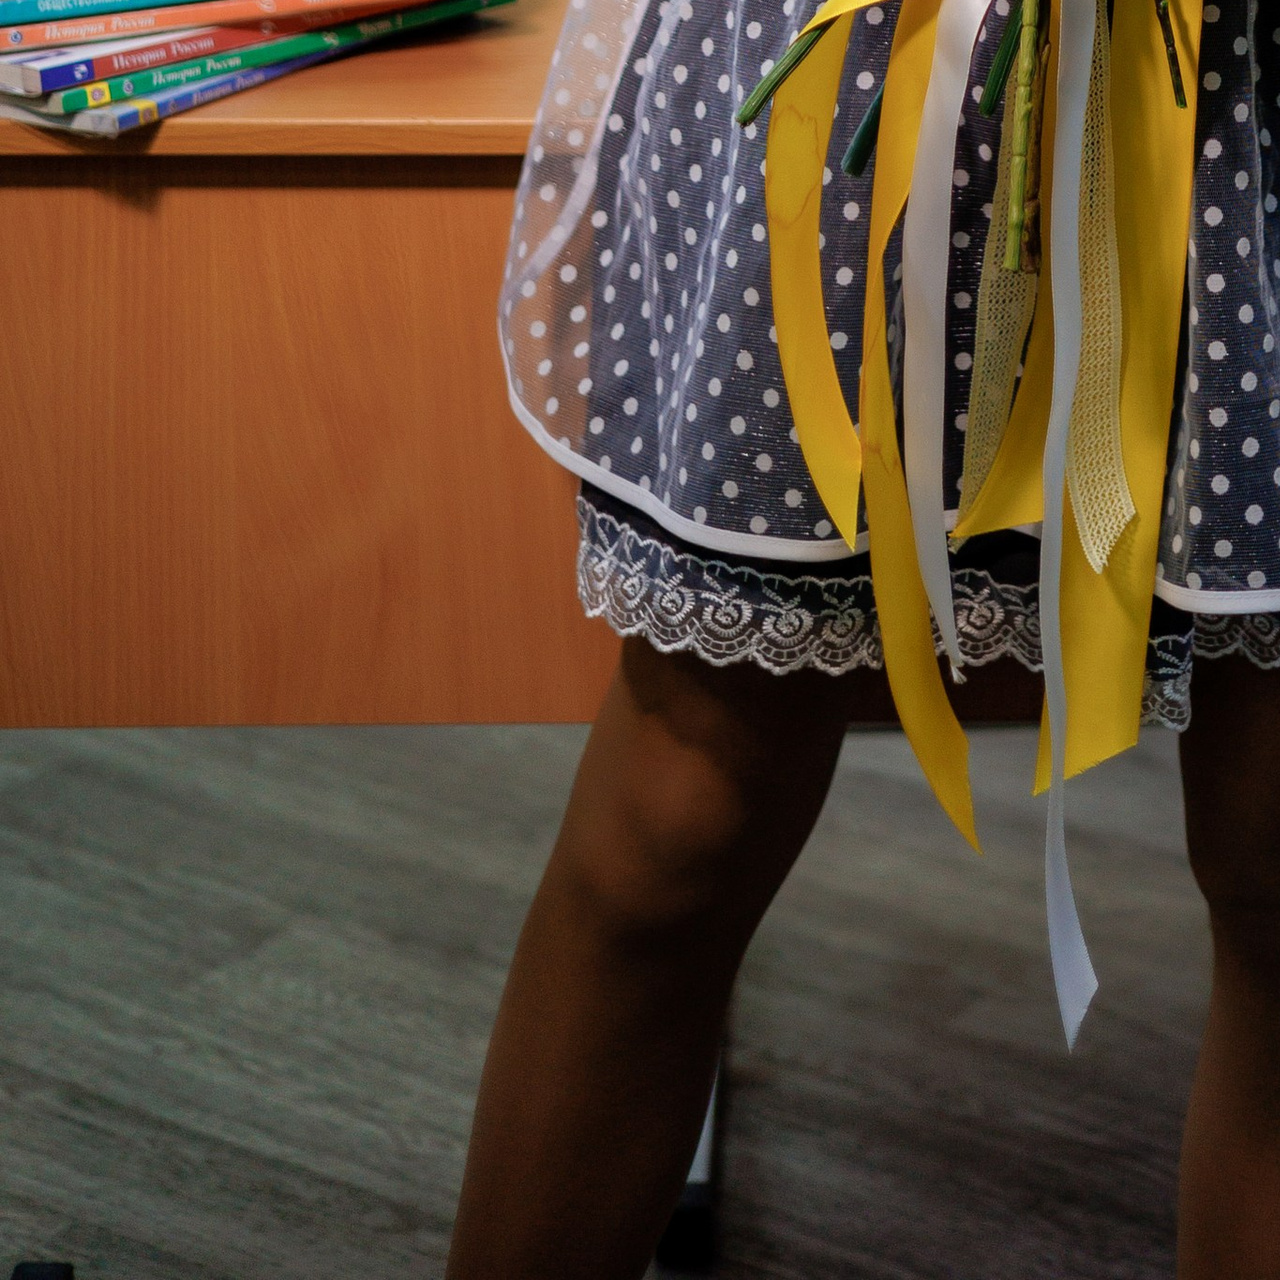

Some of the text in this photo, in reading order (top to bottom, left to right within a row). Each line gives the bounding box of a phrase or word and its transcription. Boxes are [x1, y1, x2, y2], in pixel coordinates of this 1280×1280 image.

[112, 47, 167, 71] История
[171, 36, 216, 57] России
[152, 65, 202, 87] История
